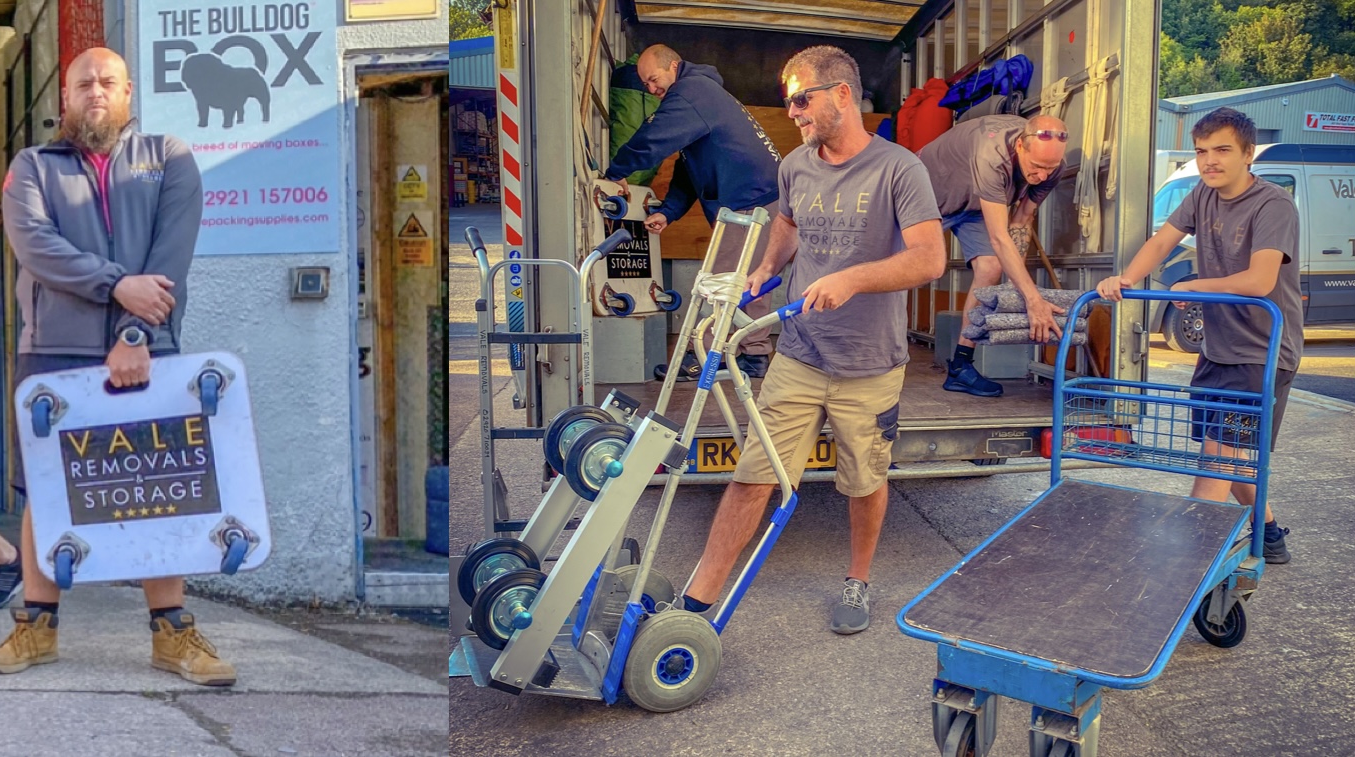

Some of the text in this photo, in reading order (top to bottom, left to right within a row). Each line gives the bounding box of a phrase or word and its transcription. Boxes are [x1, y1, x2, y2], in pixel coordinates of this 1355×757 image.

[158, 2, 309, 37] THE BULLDOG
[153, 31, 324, 93] BOX
[192, 142, 225, 151] breed
[228, 141, 238, 150] of
[242, 139, 282, 151] moving
[204, 187, 328, 206] 2921 157006
[1329, 179, 1355, 199] Val
[793, 192, 870, 214] VALE
[201, 213, 329, 227] epackingsupplies.com
[794, 216, 868, 228] EMOVALS
[617, 240, 649, 250] MOVALS
[799, 232, 860, 246] ORAGE
[611, 258, 648, 268] STORAGE
[479, 329, 487, 349] VALE
[67, 416, 206, 458] VALE
[991, 430, 1028, 438] Master
[70, 447, 207, 478] REMOVALS
[702, 442, 742, 467] RK
[136, 473, 144, 484] &
[84, 480, 203, 509] STORAGE
